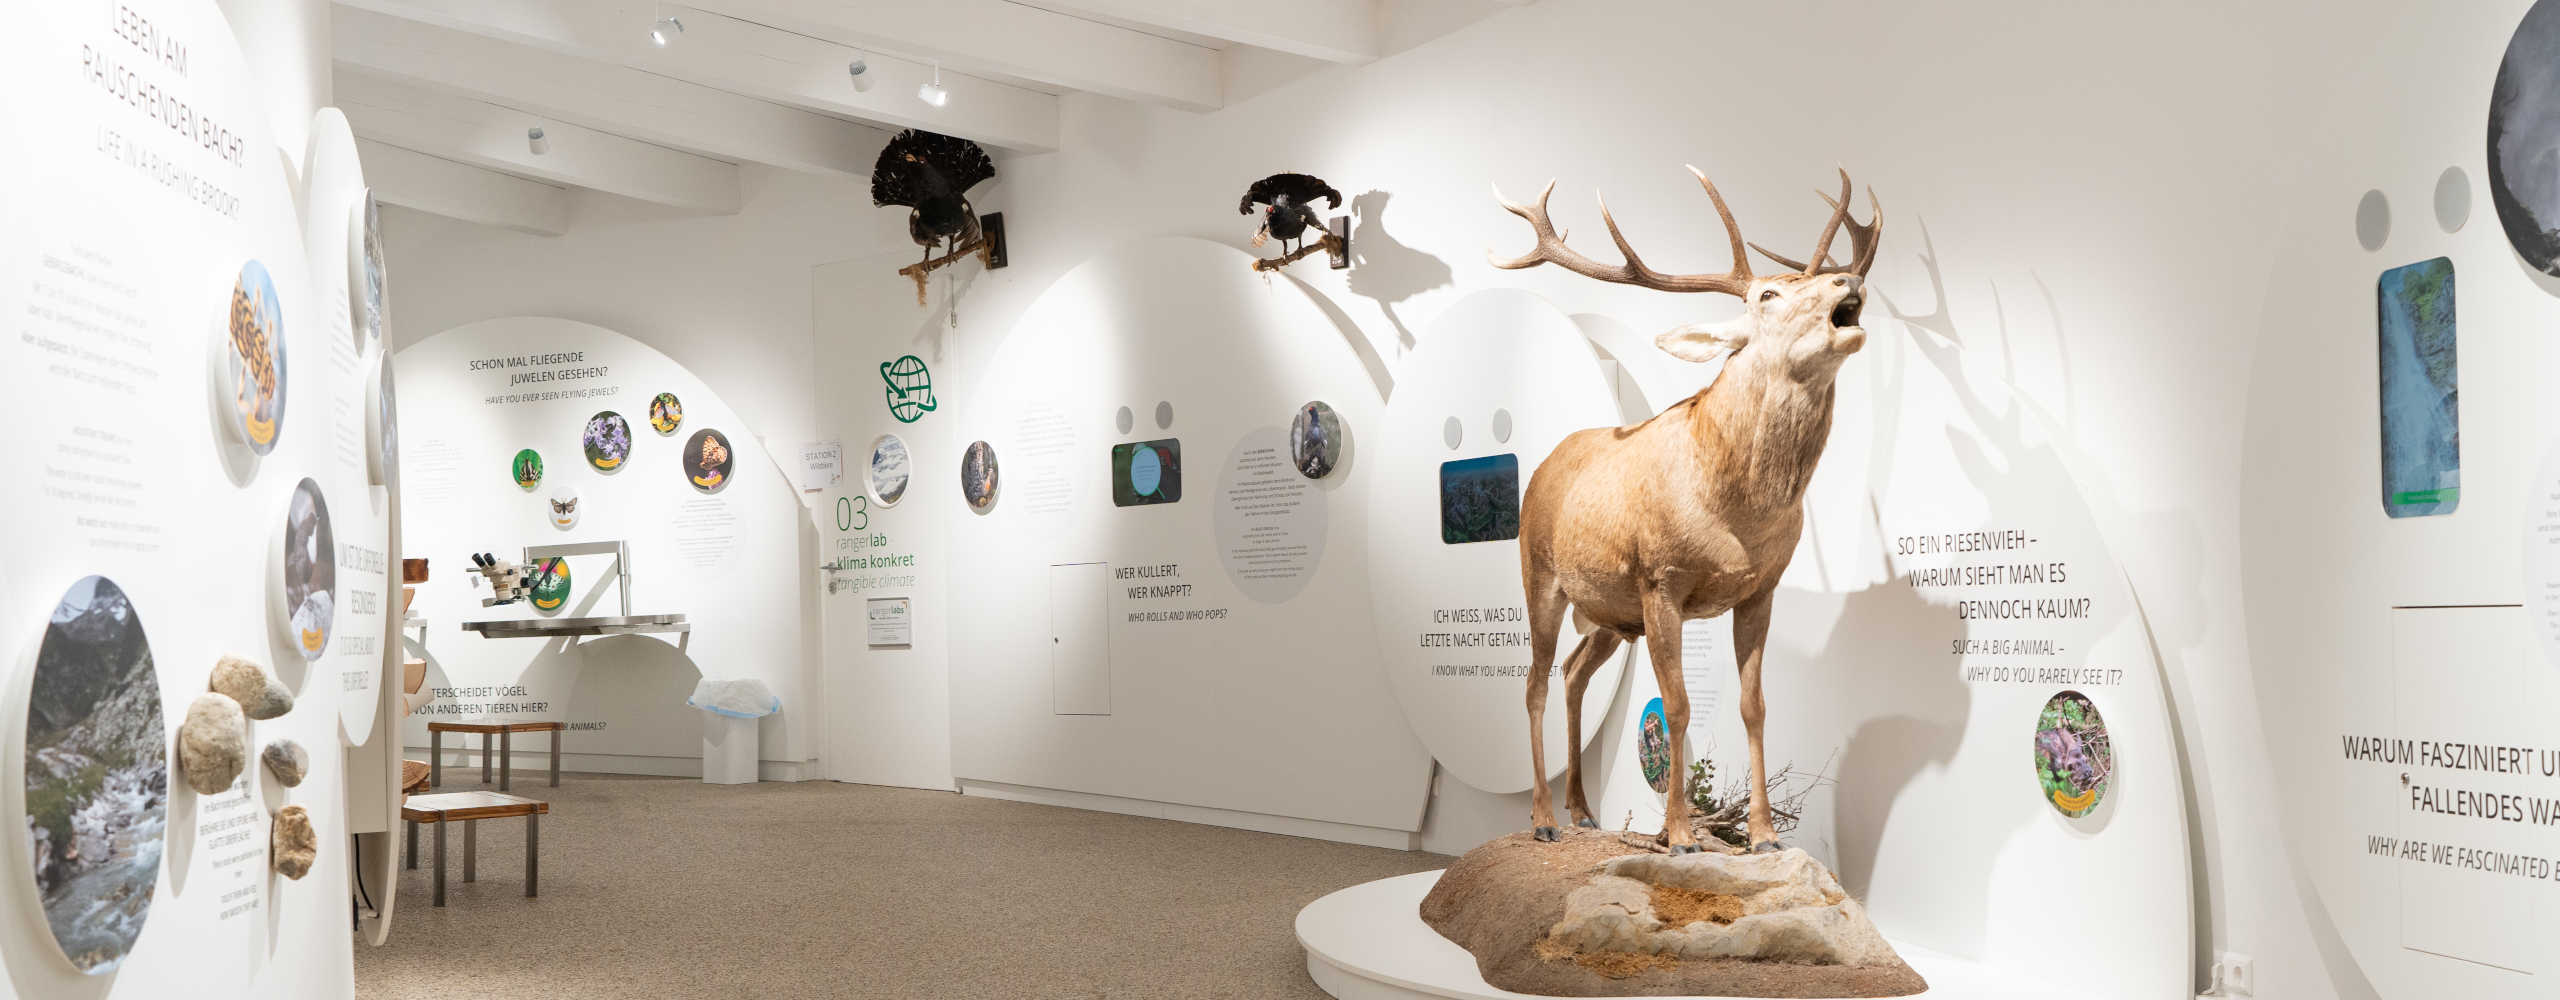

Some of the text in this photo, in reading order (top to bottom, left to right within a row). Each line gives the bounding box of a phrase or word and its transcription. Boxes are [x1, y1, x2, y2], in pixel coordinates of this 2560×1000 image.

[112, 0, 188, 78] LEBEN AM
[83, 43, 243, 168] RAUSCHENDEN BACH?
[98, 122, 240, 221] LIFE IN A RUSHING BROOK?
[469, 351, 584, 371] SCHON MAL FLIEGENDE
[510, 366, 608, 387] JUWELEN GESEHEN?
[485, 395, 504, 404] HAVE
[506, 394, 520, 403] YOU
[522, 393, 540, 402] EVER
[541, 391, 559, 401] SEEN
[561, 389, 587, 399] FLYING
[836, 495, 869, 532] 03
[836, 532, 887, 553] rangerlab
[1898, 536, 1914, 555] SO
[1919, 535, 1940, 554] EIN
[1945, 529, 2025, 553] RIESENVIEH
[837, 553, 915, 570] klima konkret
[1114, 564, 1180, 579] WER KULLERT,
[837, 573, 916, 593] tangible climate
[1908, 562, 2066, 587] WARUM SIEHT MAN ES
[1127, 584, 1192, 599] WER KNAPPT?
[1128, 608, 1228, 622] WHO ROLLS AND WHO POPS?
[1433, 607, 1522, 624] ICH WEISS, WAS DU
[1959, 598, 2090, 620] DENNOCH KAUM?
[1420, 633, 1450, 647] LETZTE
[1454, 633, 1485, 647] NACHT
[1488, 632, 1520, 647] GETAN
[1952, 639, 1979, 655] SUCH
[1982, 640, 1989, 655] A
[1992, 639, 2010, 655] BIG
[2012, 639, 2055, 656] ANIMAL
[1436, 665, 1457, 677] KNOW
[1459, 665, 1479, 677] WHAT
[1481, 665, 1495, 677] YOU
[1497, 665, 1516, 677] HAVE
[1967, 666, 2123, 686] WHY DO YOU RARELY SEE IT?
[437, 703, 482, 714] ANDEREN
[485, 702, 518, 713] TIEREN
[521, 702, 548, 713] HIER?
[2342, 735, 2414, 765] WARUM
[2421, 741, 2534, 775] FASZINIERT
[2412, 785, 2523, 823] FALLENDES
[2368, 834, 2398, 858] WHY
[2400, 840, 2428, 862] ARE
[2432, 843, 2453, 866] WE
[2457, 847, 2549, 880] FASCINATED
